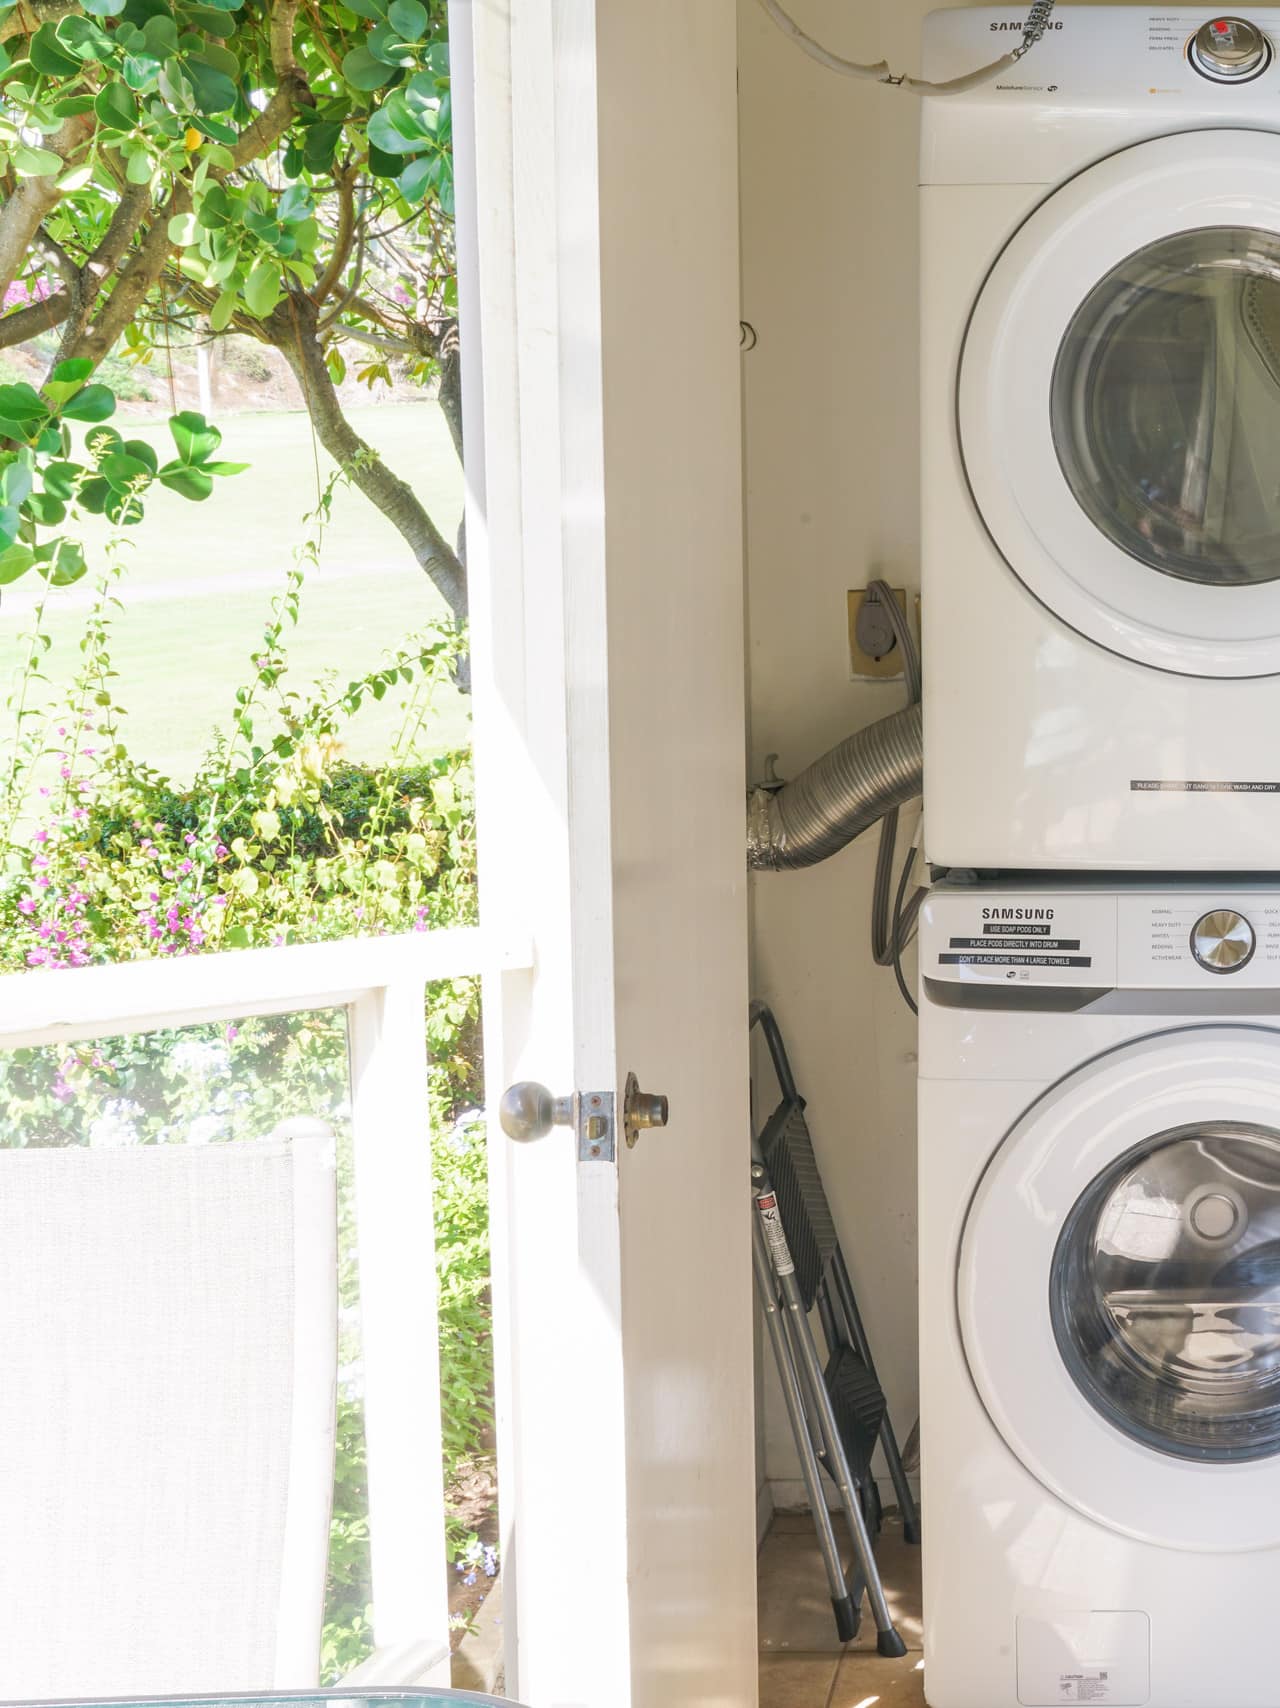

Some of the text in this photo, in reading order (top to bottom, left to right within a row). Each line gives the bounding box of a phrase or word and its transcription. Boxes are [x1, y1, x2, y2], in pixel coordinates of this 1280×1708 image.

[990, 22, 1064, 31] SAMNG
[982, 908, 1054, 920] SAMSUNG
[1033, 926, 1047, 934] ONLY
[995, 956, 1009, 964] MORE
